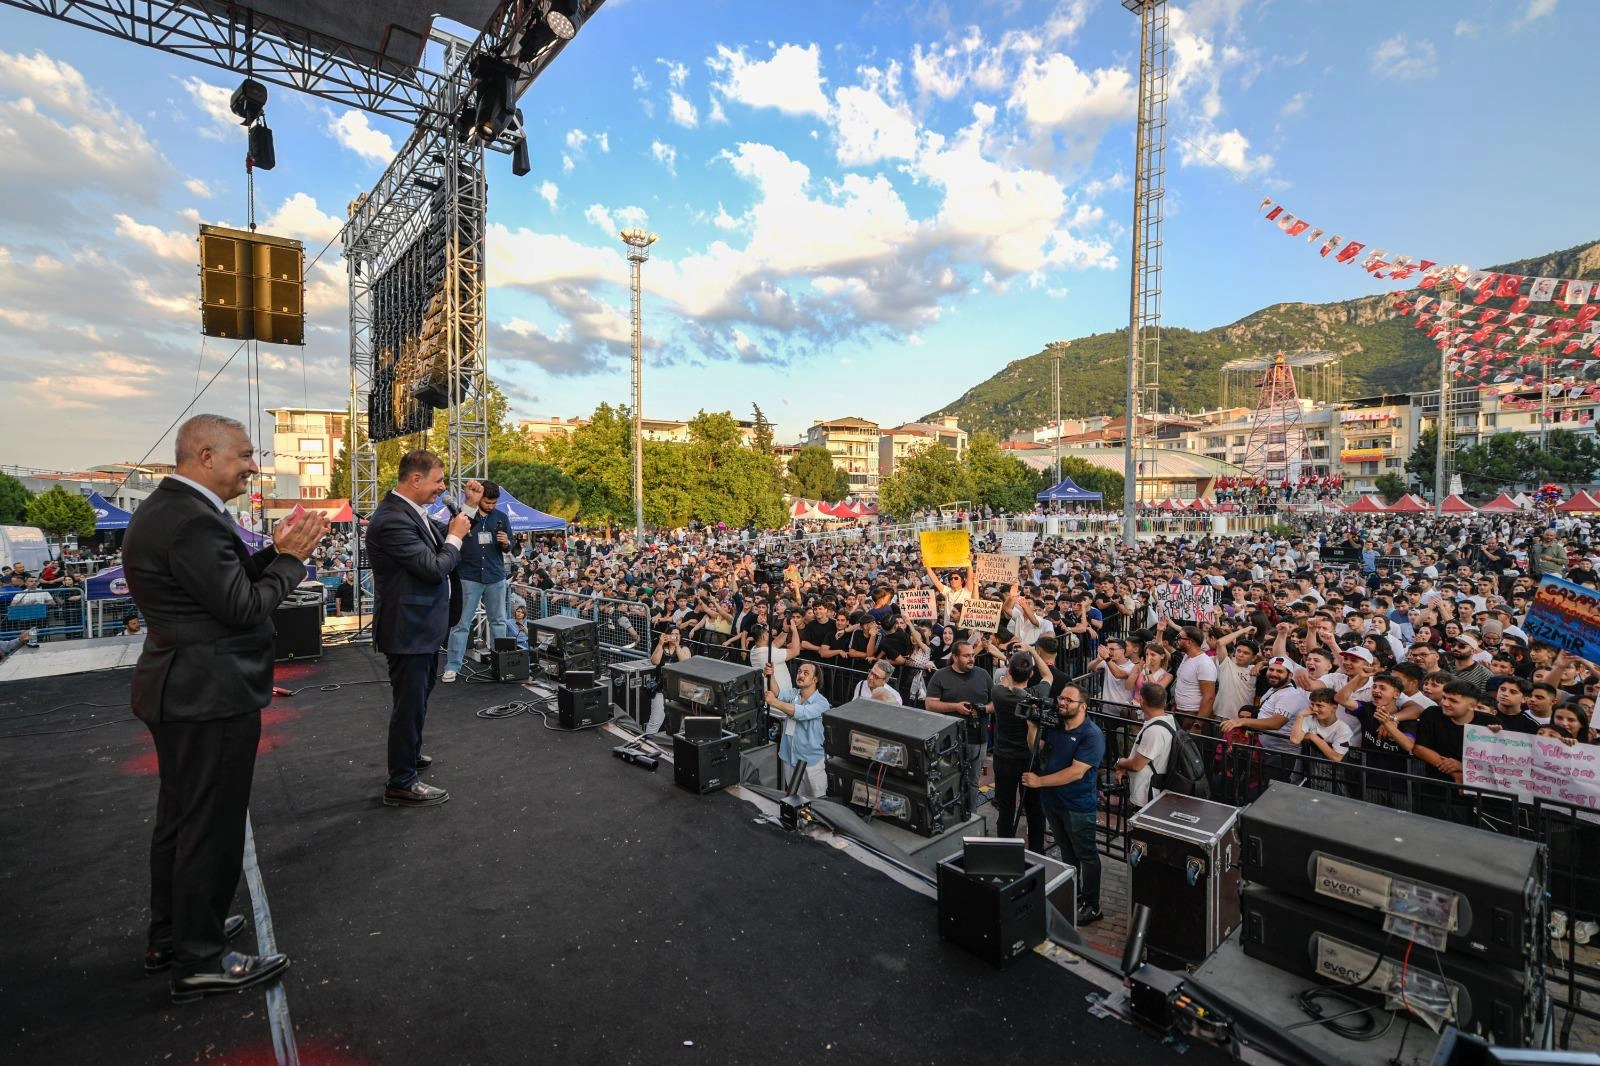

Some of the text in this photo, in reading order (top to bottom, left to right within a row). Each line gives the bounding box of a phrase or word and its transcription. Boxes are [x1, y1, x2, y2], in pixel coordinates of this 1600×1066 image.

[907, 610, 932, 618] YALAN
[1323, 879, 1361, 896] event
[1323, 961, 1361, 980] event
